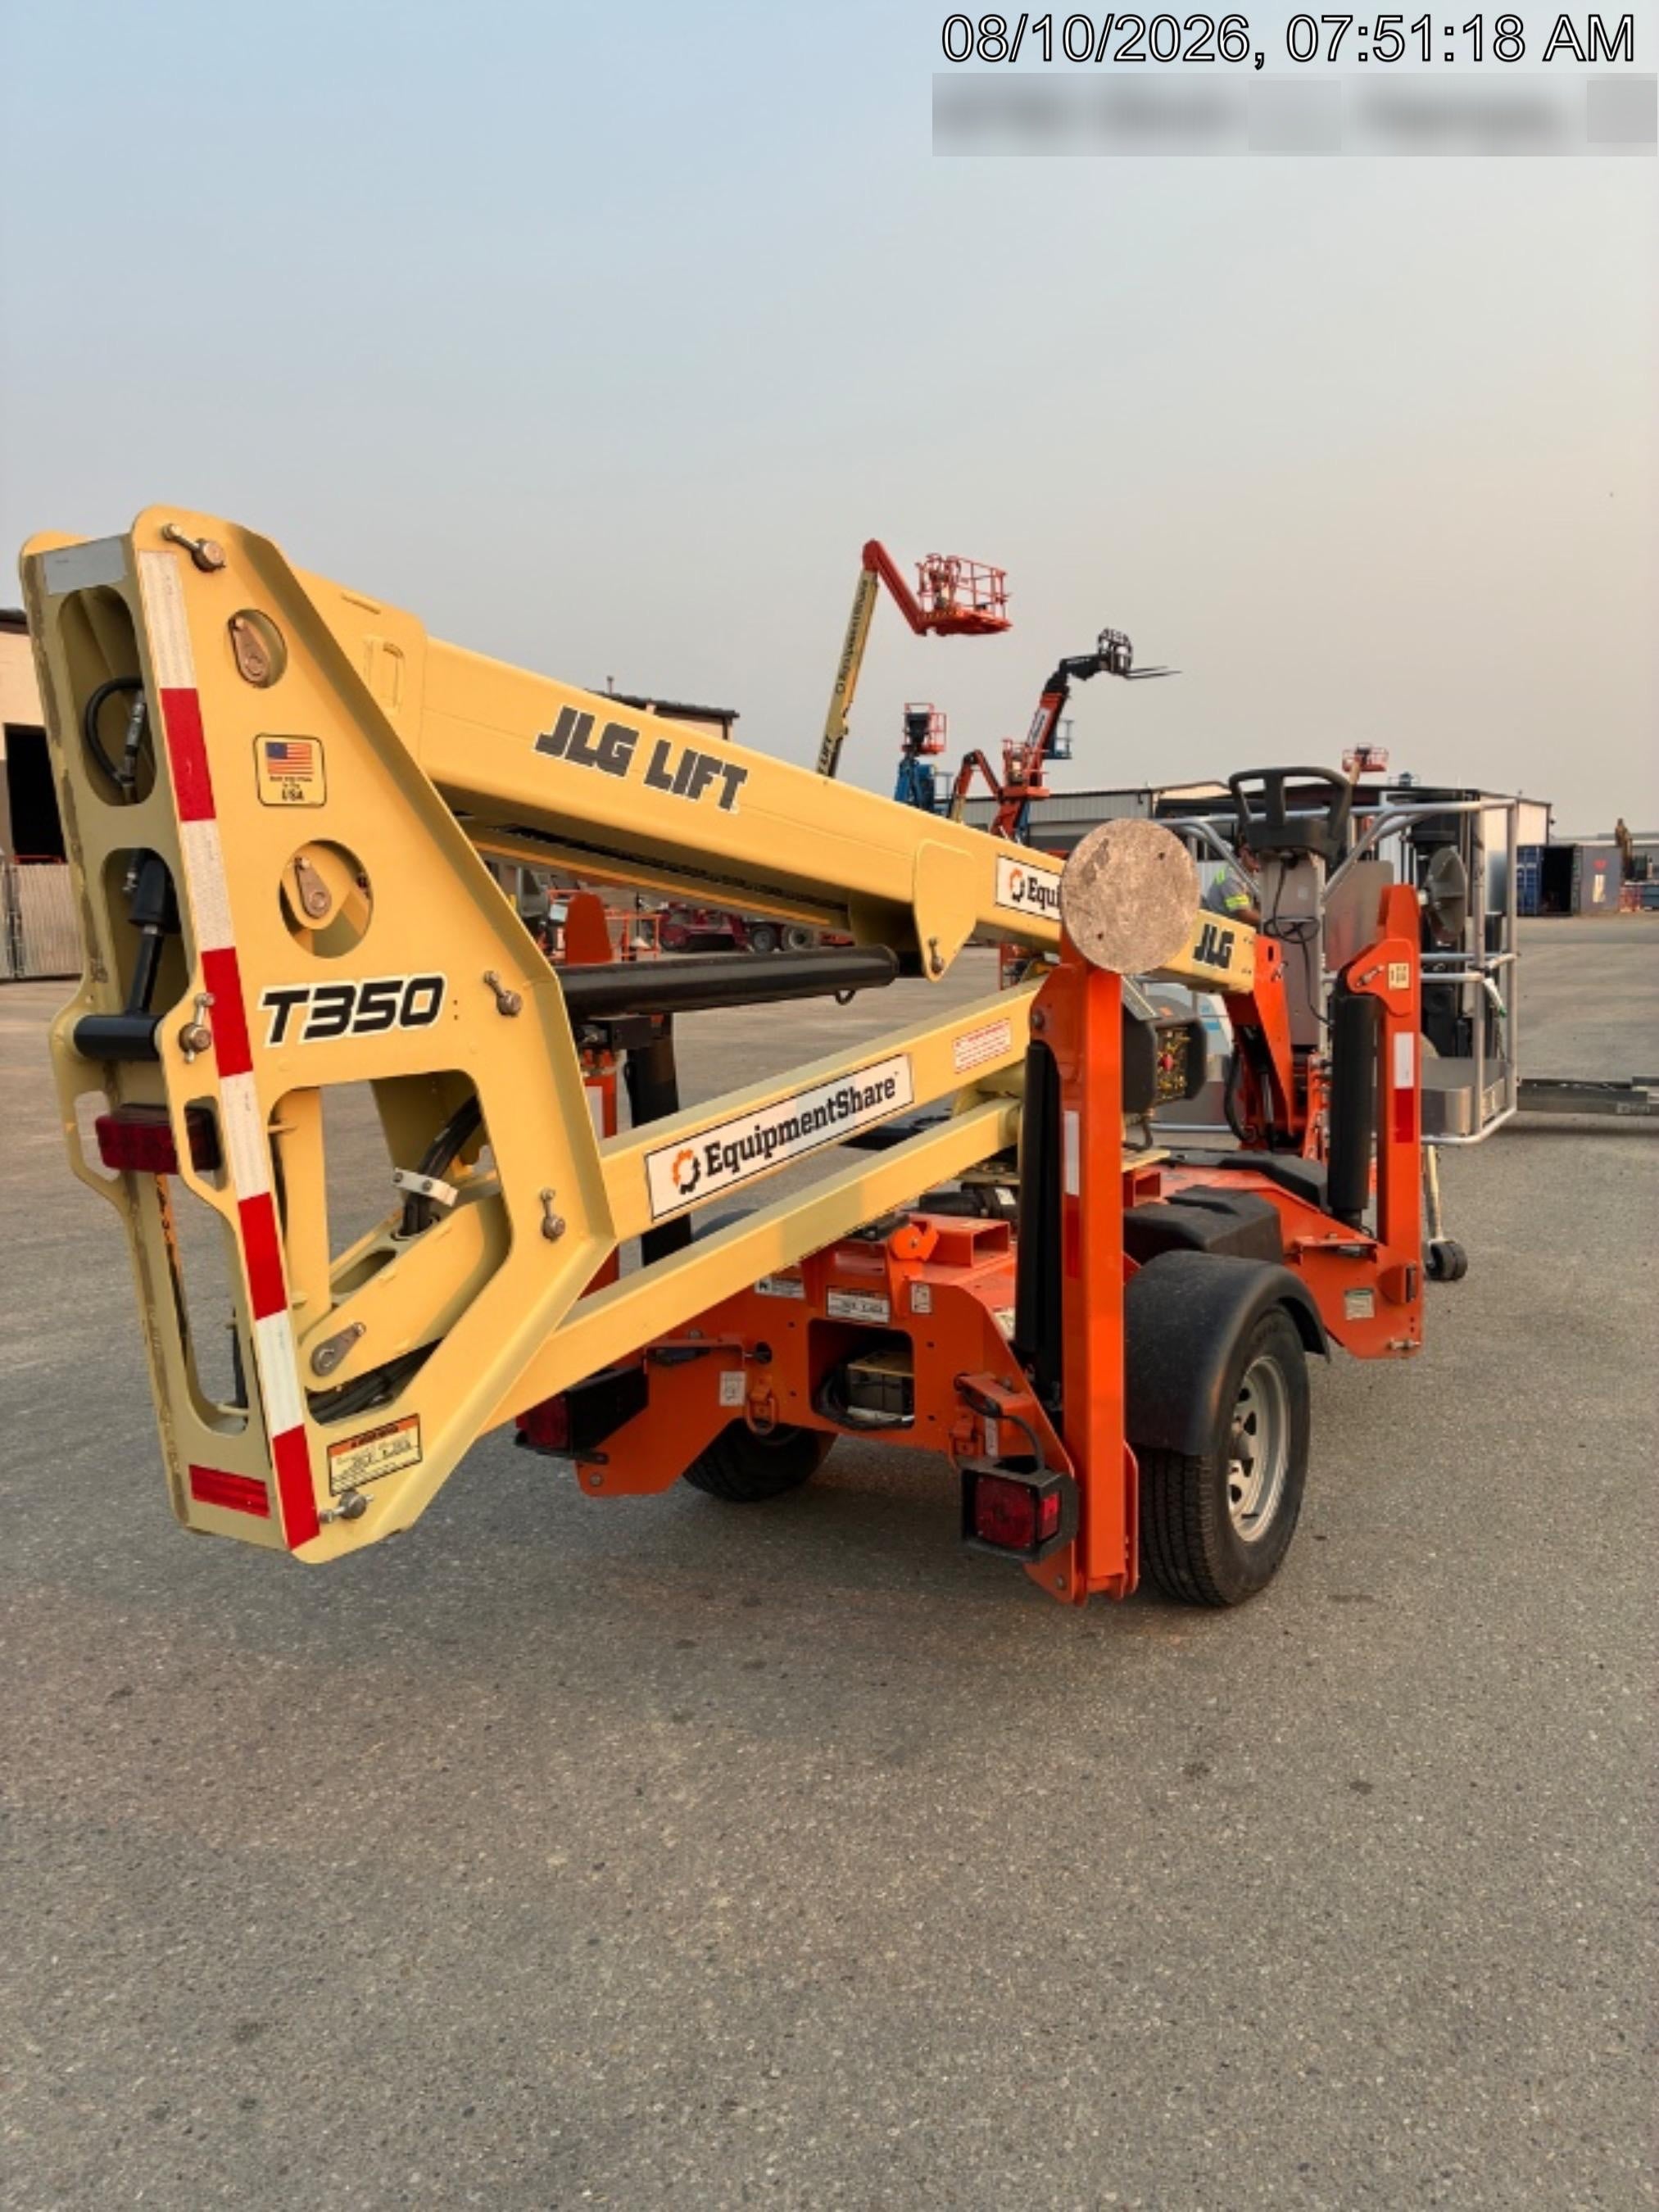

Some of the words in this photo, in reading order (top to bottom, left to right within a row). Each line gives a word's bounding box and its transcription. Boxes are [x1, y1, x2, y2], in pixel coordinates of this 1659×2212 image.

[534, 705, 640, 778] JLG
[643, 739, 749, 811] LIFT
[1192, 922, 1235, 969] JLG
[261, 974, 446, 1045] T350
[704, 1074, 896, 1177] EquipmentShare
